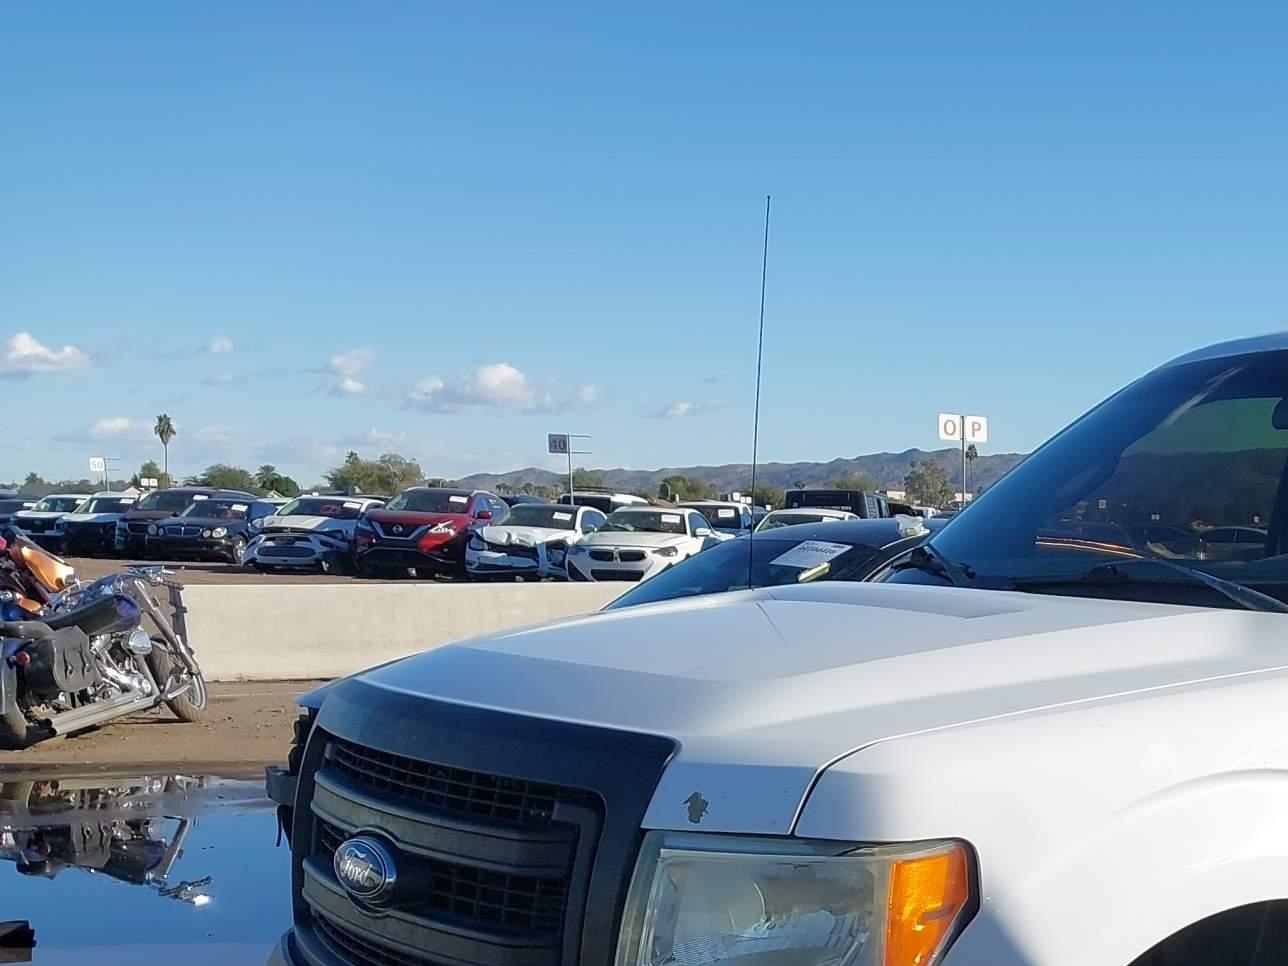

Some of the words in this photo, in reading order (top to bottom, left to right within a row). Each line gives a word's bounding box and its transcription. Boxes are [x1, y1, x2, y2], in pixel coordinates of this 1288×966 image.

[943, 419, 957, 436] O
[971, 421, 982, 438] P
[341, 847, 381, 888] Ford
